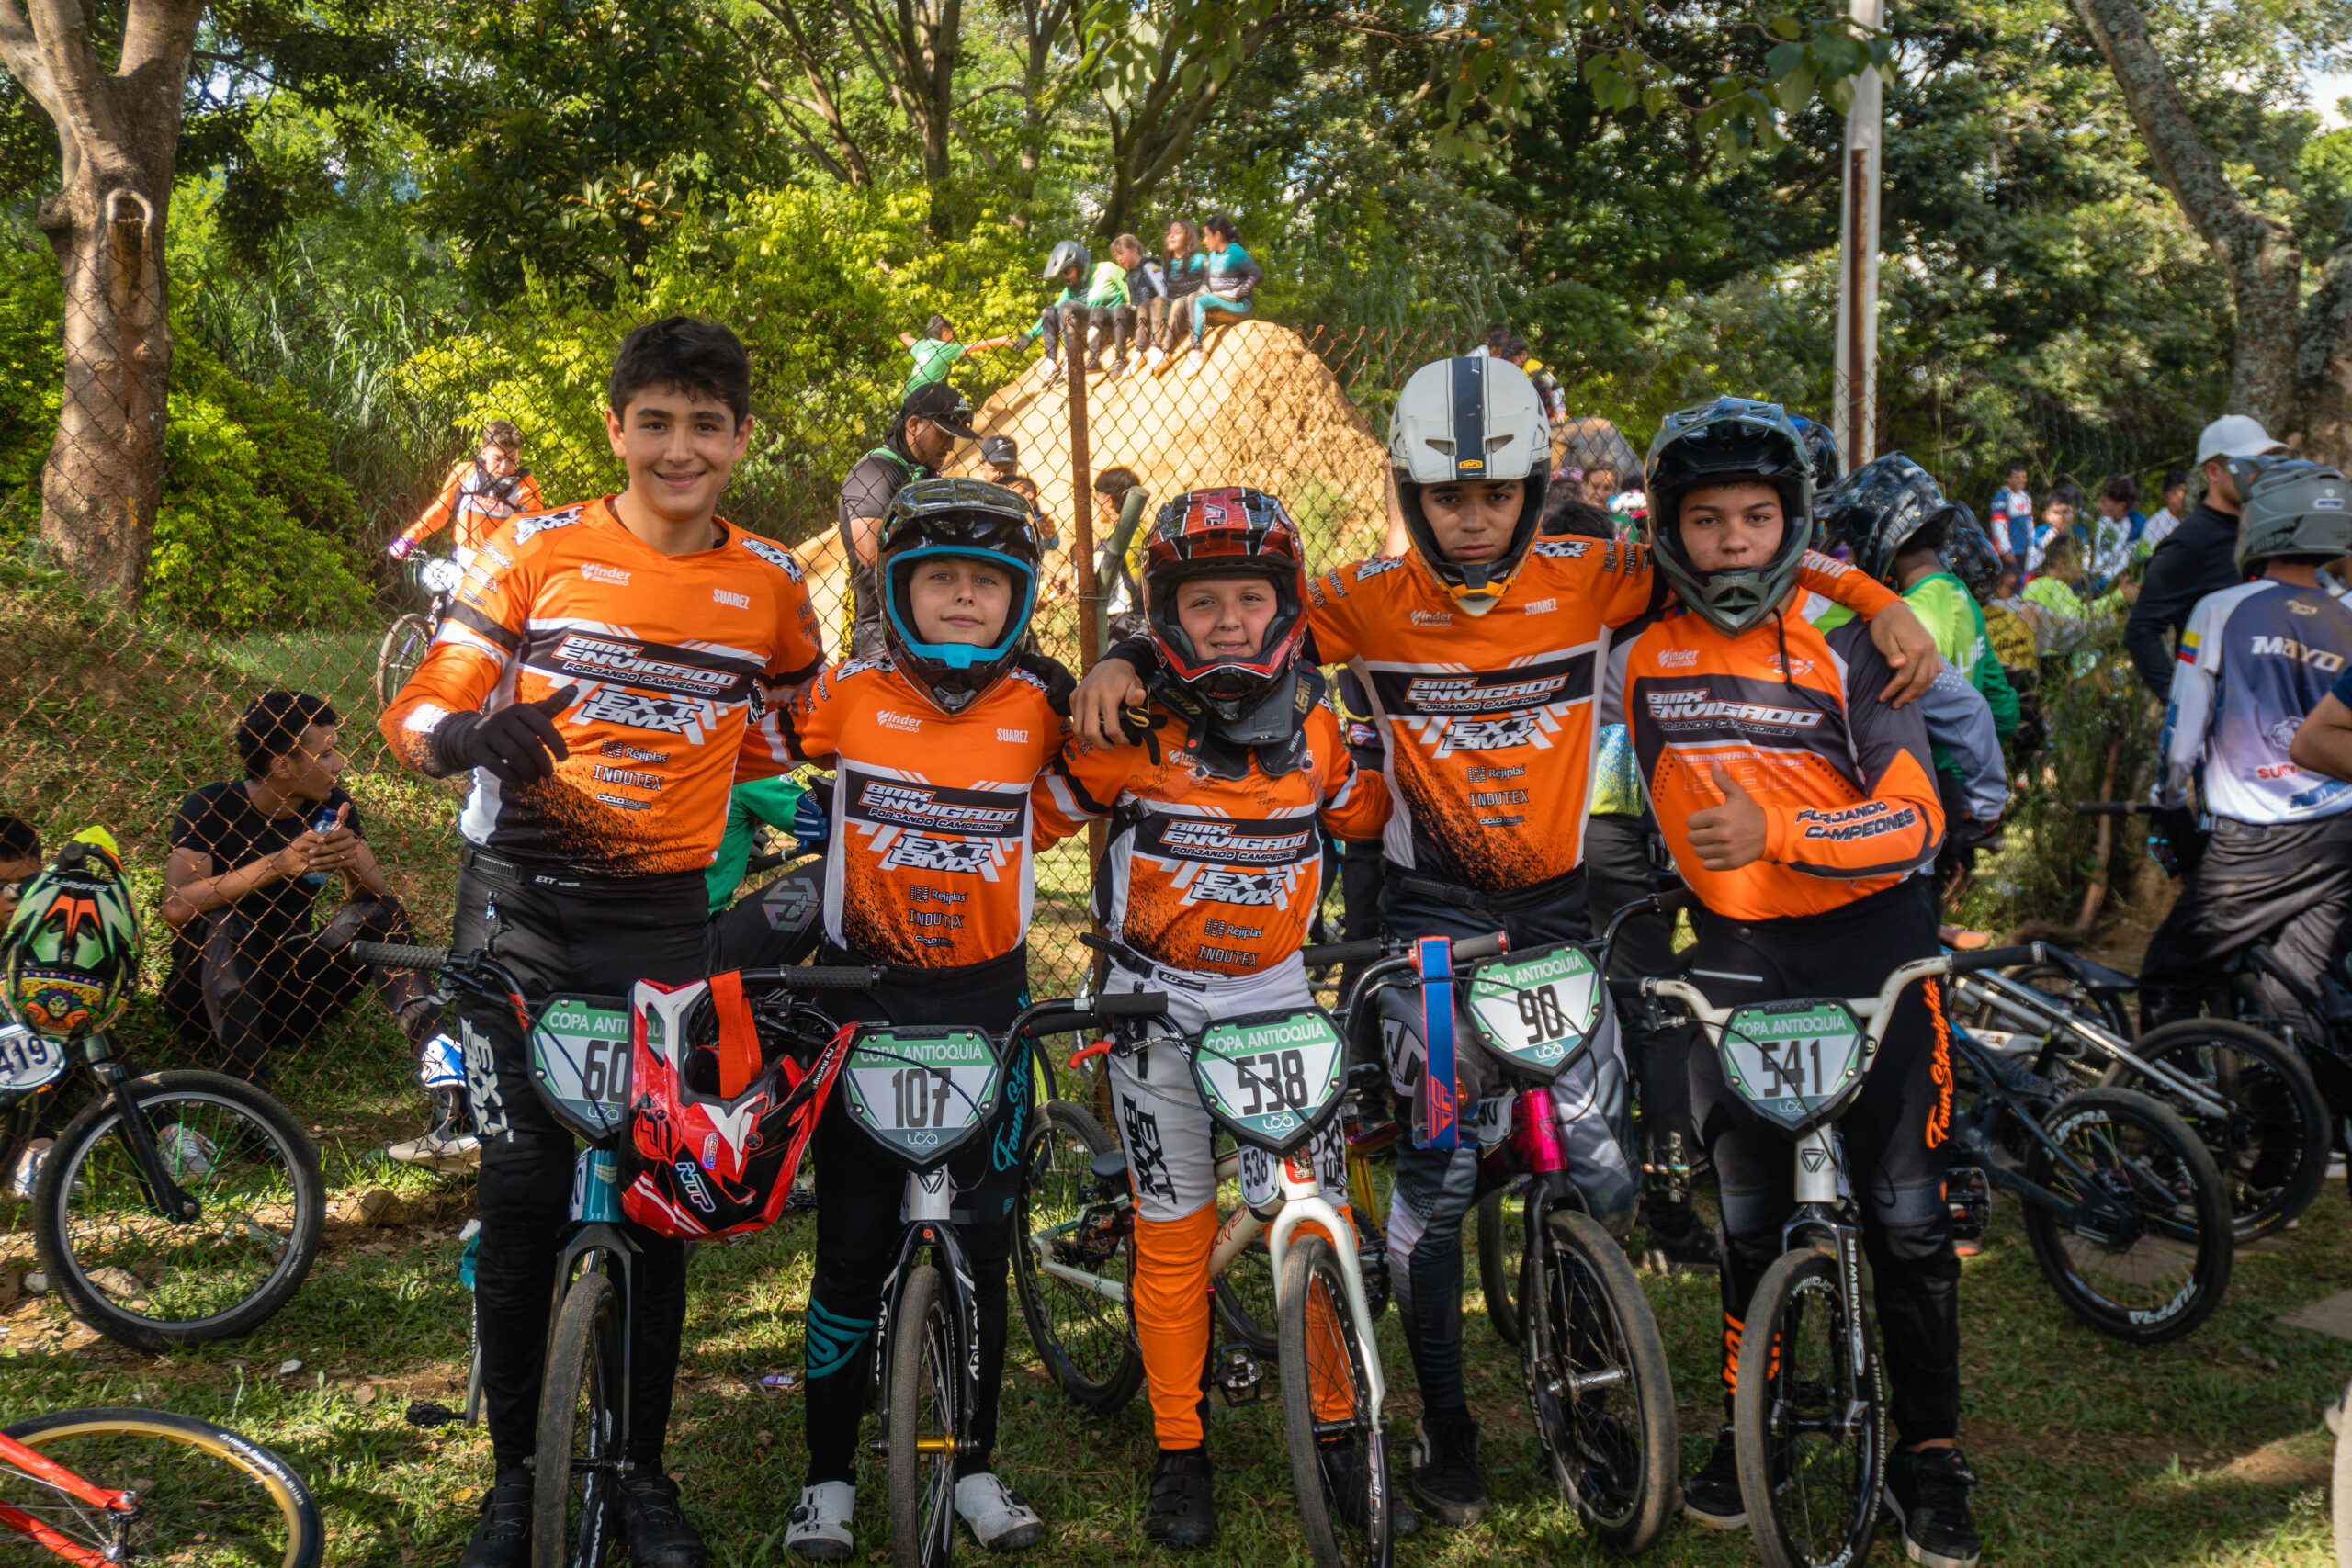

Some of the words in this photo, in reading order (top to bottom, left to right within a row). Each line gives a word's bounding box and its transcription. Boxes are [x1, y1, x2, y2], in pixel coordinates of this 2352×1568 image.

[712, 588, 751, 610] SUAREZ
[1524, 598, 1558, 616] SUAREZ
[564, 636, 640, 658] BMX
[2250, 636, 2345, 673] MAYO
[555, 647, 739, 687] ENVIGADO
[562, 661, 639, 682] FORJANDO
[640, 674, 720, 694] CAMPEONES
[1407, 676, 1568, 703] ENVIGADO
[1412, 679, 1475, 690] BMX
[598, 688, 705, 719] EXT
[1417, 701, 1480, 711] FORJANDO
[1483, 693, 1552, 710] CAMPEONES
[1646, 690, 1708, 705] BMX
[581, 700, 696, 734] BMX
[1451, 712, 1541, 737] EXT
[1649, 700, 1824, 727] ENVIGADO
[885, 723, 920, 733] ENVIGADO
[996, 728, 1029, 743] SUAREZ
[1442, 726, 1537, 751] BMX
[1715, 718, 1797, 736] CAMPEONES
[625, 746, 668, 763] Rejiplas
[593, 764, 665, 791] INDUTEX
[1488, 765, 1526, 780] Rejiplas
[865, 783, 933, 802] BMX
[1469, 788, 1530, 807] INDUTEX
[860, 793, 1019, 822] ENVIGADO
[868, 807, 934, 826] FORJANDO
[936, 820, 1004, 832] CAMPEONES
[1794, 800, 1890, 825] FORJANDO
[1169, 821, 1235, 836] BMX
[1804, 807, 1917, 842] CAMPEONES
[901, 834, 993, 860] EXT
[1161, 831, 1310, 852] ENVIGADO
[1170, 845, 1237, 860] FORJANDO
[1238, 849, 1298, 862] CAMPEONES
[888, 846, 989, 874] BMX
[1202, 869, 1288, 891] EXT
[931, 889, 967, 905] Rejiplas
[1190, 881, 1283, 906] BMX
[1227, 924, 1263, 940] Rejiplas
[1197, 945, 1260, 966] INDUTEX
[1476, 973, 1513, 994] COPA
[1515, 954, 1585, 986] ANTIOQUIA
[548, 1011, 590, 1032] COPA
[1517, 983, 1566, 1046] 90
[1735, 1021, 1770, 1037] COPA
[1772, 1014, 1847, 1034] ANTIOQUIA
[1206, 1036, 1245, 1054] COPA
[1247, 1021, 1327, 1049] ANTIOQUIA
[0, 1034, 49, 1076] 419
[859, 1045, 899, 1063] COPA
[903, 1043, 984, 1062] ANTIOQUIA
[582, 1039, 627, 1103] 60
[1761, 1038, 1823, 1099] 541
[1235, 1048, 1309, 1116] 538
[892, 1067, 952, 1128] 107
[1242, 1147, 1269, 1190] 538
[1847, 1237, 1860, 1324] ANSWER
